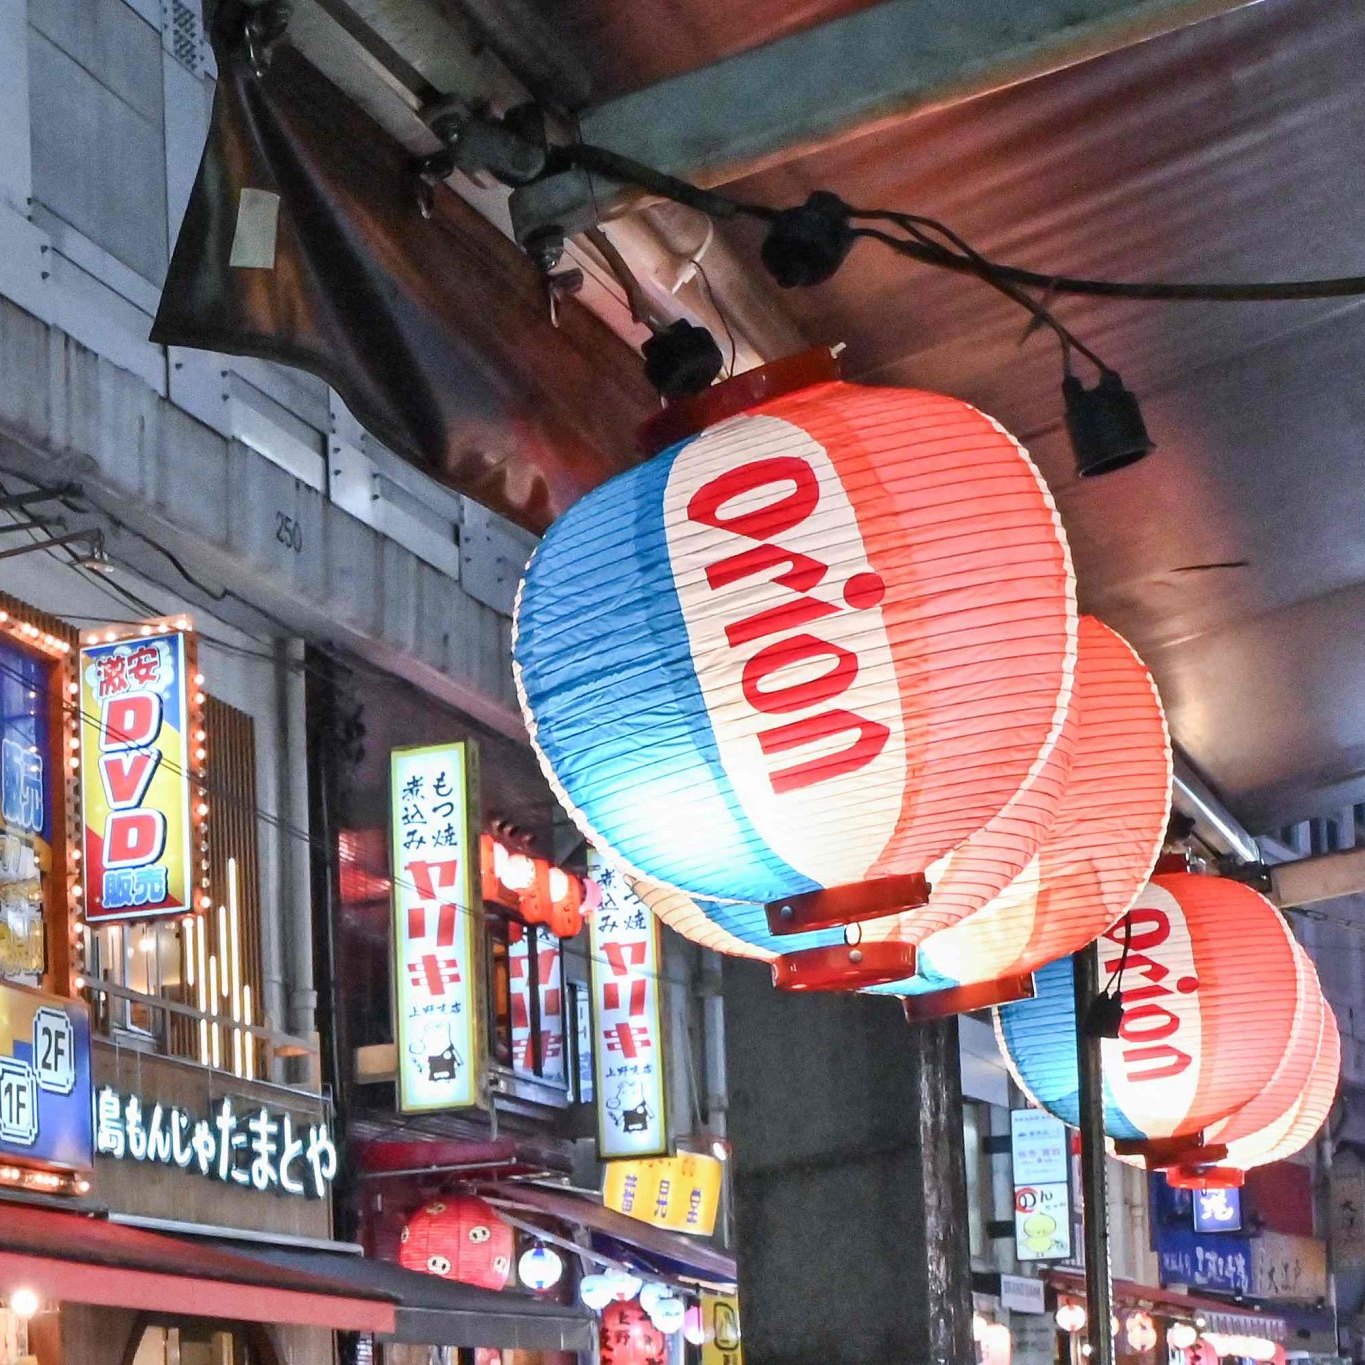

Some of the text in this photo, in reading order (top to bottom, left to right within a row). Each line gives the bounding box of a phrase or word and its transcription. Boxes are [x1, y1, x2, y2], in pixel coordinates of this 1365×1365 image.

[275, 509, 303, 557] 250
[688, 455, 891, 795] Orion
[95, 648, 161, 694] 激安
[100, 692, 166, 866] DVD
[402, 775, 428, 851] 煮込み
[431, 771, 459, 849] もつ焼
[100, 865, 167, 908] 販売
[597, 867, 621, 933] 煮込み
[403, 858, 463, 997] ヤリキ
[598, 940, 652, 1060] ヤリキ
[1100, 907, 1200, 1083] Orion
[42, 1026, 66, 1072] 2F
[3, 1092, 27, 1130] 1F
[91, 1084, 337, 1199] 島もんじゃたまとや
